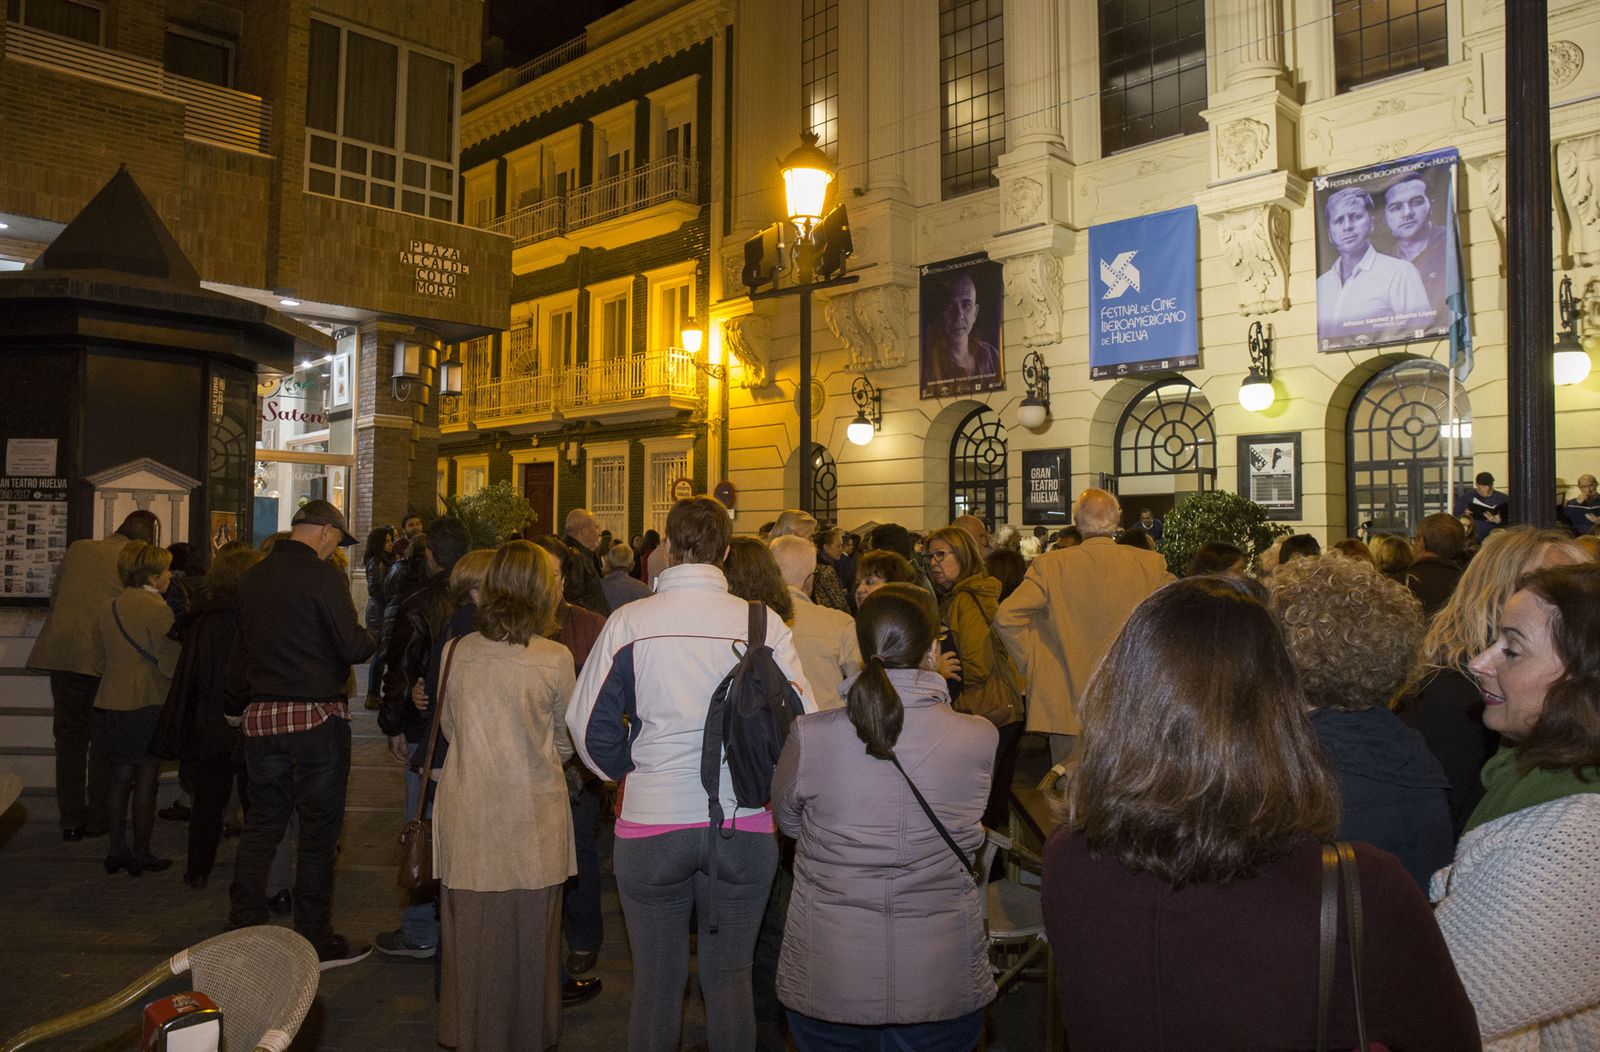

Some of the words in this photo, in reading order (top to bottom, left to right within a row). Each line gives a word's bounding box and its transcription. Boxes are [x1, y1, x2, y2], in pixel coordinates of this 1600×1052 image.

[412, 241, 459, 260] PLAZA
[401, 252, 468, 273] ALCALDE
[417, 268, 455, 285] COTO
[416, 281, 454, 298] MORA
[1101, 303, 1139, 320] FESTIVAL
[1151, 298, 1177, 312] CINE
[1101, 310, 1187, 333] IBEROAMERICANO
[1111, 329, 1148, 344] HUELVA
[1030, 467, 1051, 479] GRAN
[0, 478, 10, 489] AN
[11, 478, 38, 489] TEATRO
[39, 478, 68, 489] HUELVA
[1031, 479, 1059, 491] TEATRO
[1030, 491, 1059, 504] HUELVA
